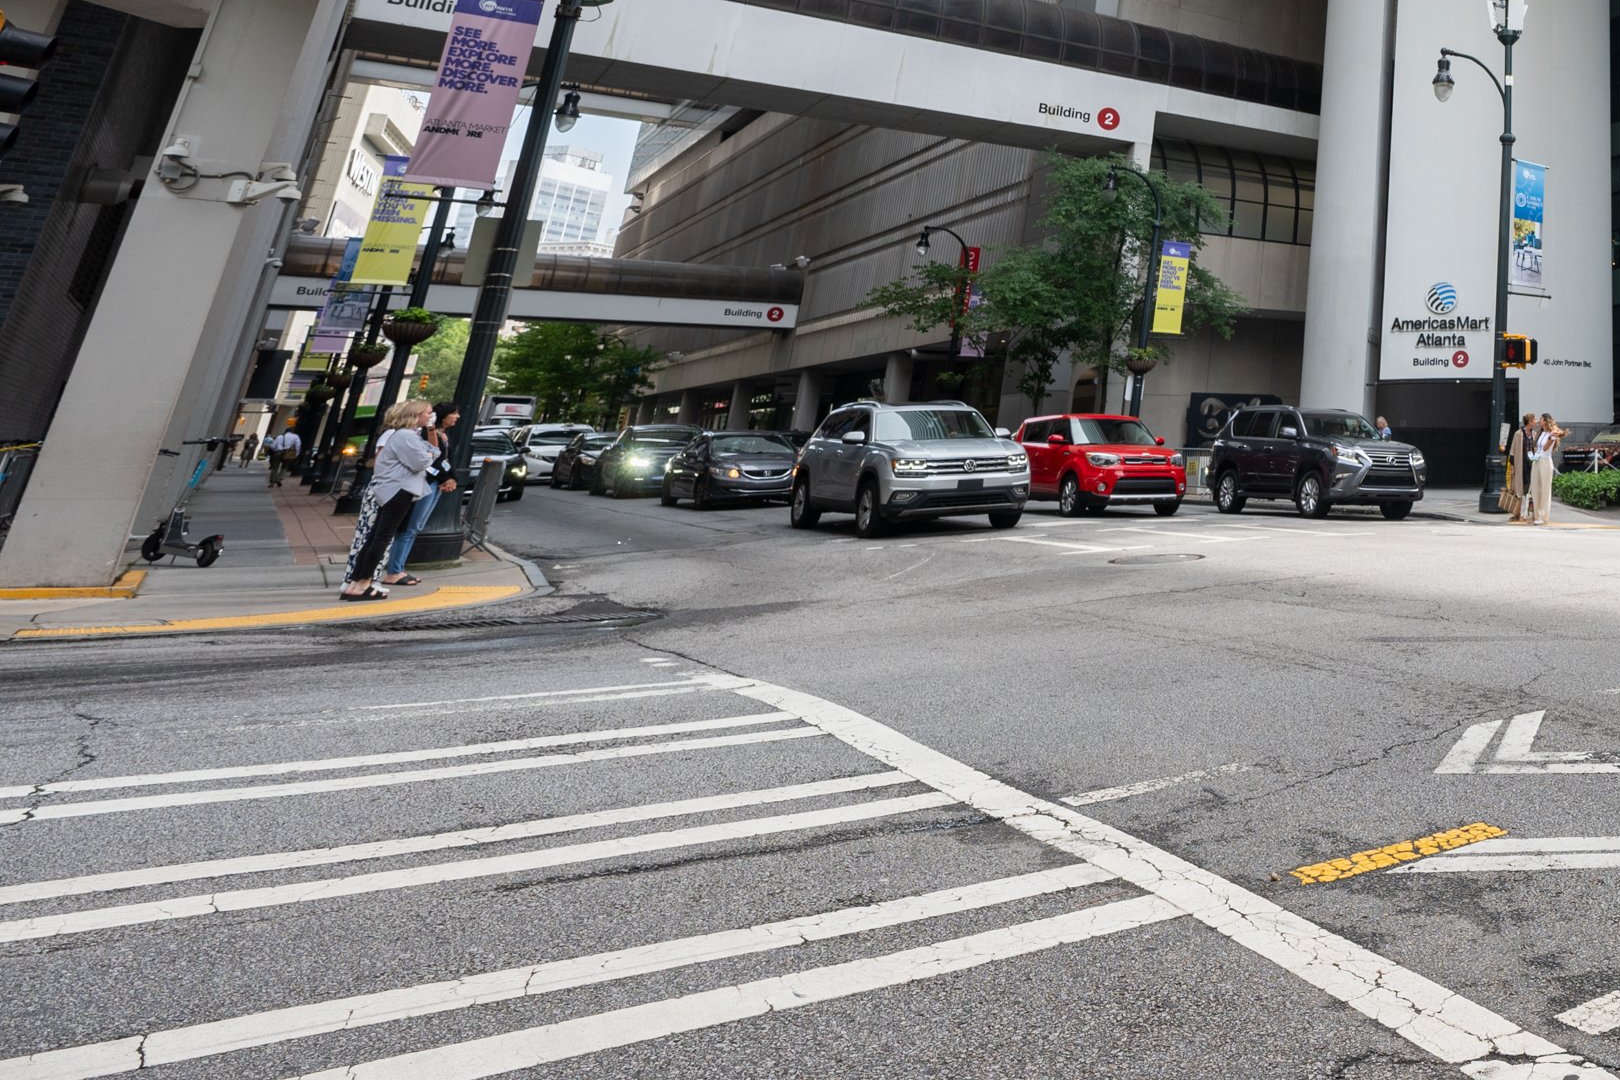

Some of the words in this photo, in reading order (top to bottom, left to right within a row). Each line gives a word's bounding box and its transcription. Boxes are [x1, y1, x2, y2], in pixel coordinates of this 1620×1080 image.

[454, 25, 482, 39] SEE
[451, 35, 499, 53] MORE.
[448, 46, 518, 66] EXPLORE
[444, 56, 494, 74] MORE.
[438, 77, 488, 94] MORE.
[441, 67, 518, 88] DISCOVER
[1038, 102, 1091, 123] Building
[1103, 112, 1114, 125] 2
[424, 118, 467, 130] ATLANTA
[468, 122, 506, 135] MARKET
[296, 286, 329, 297] Buil
[724, 307, 763, 319] Building
[1391, 316, 1490, 332] AmericasMart
[1416, 333, 1466, 348] Atlanta
[1412, 357, 1449, 367] Building
[1457, 354, 1464, 364] 2
[1564, 359, 1582, 367] Portman
